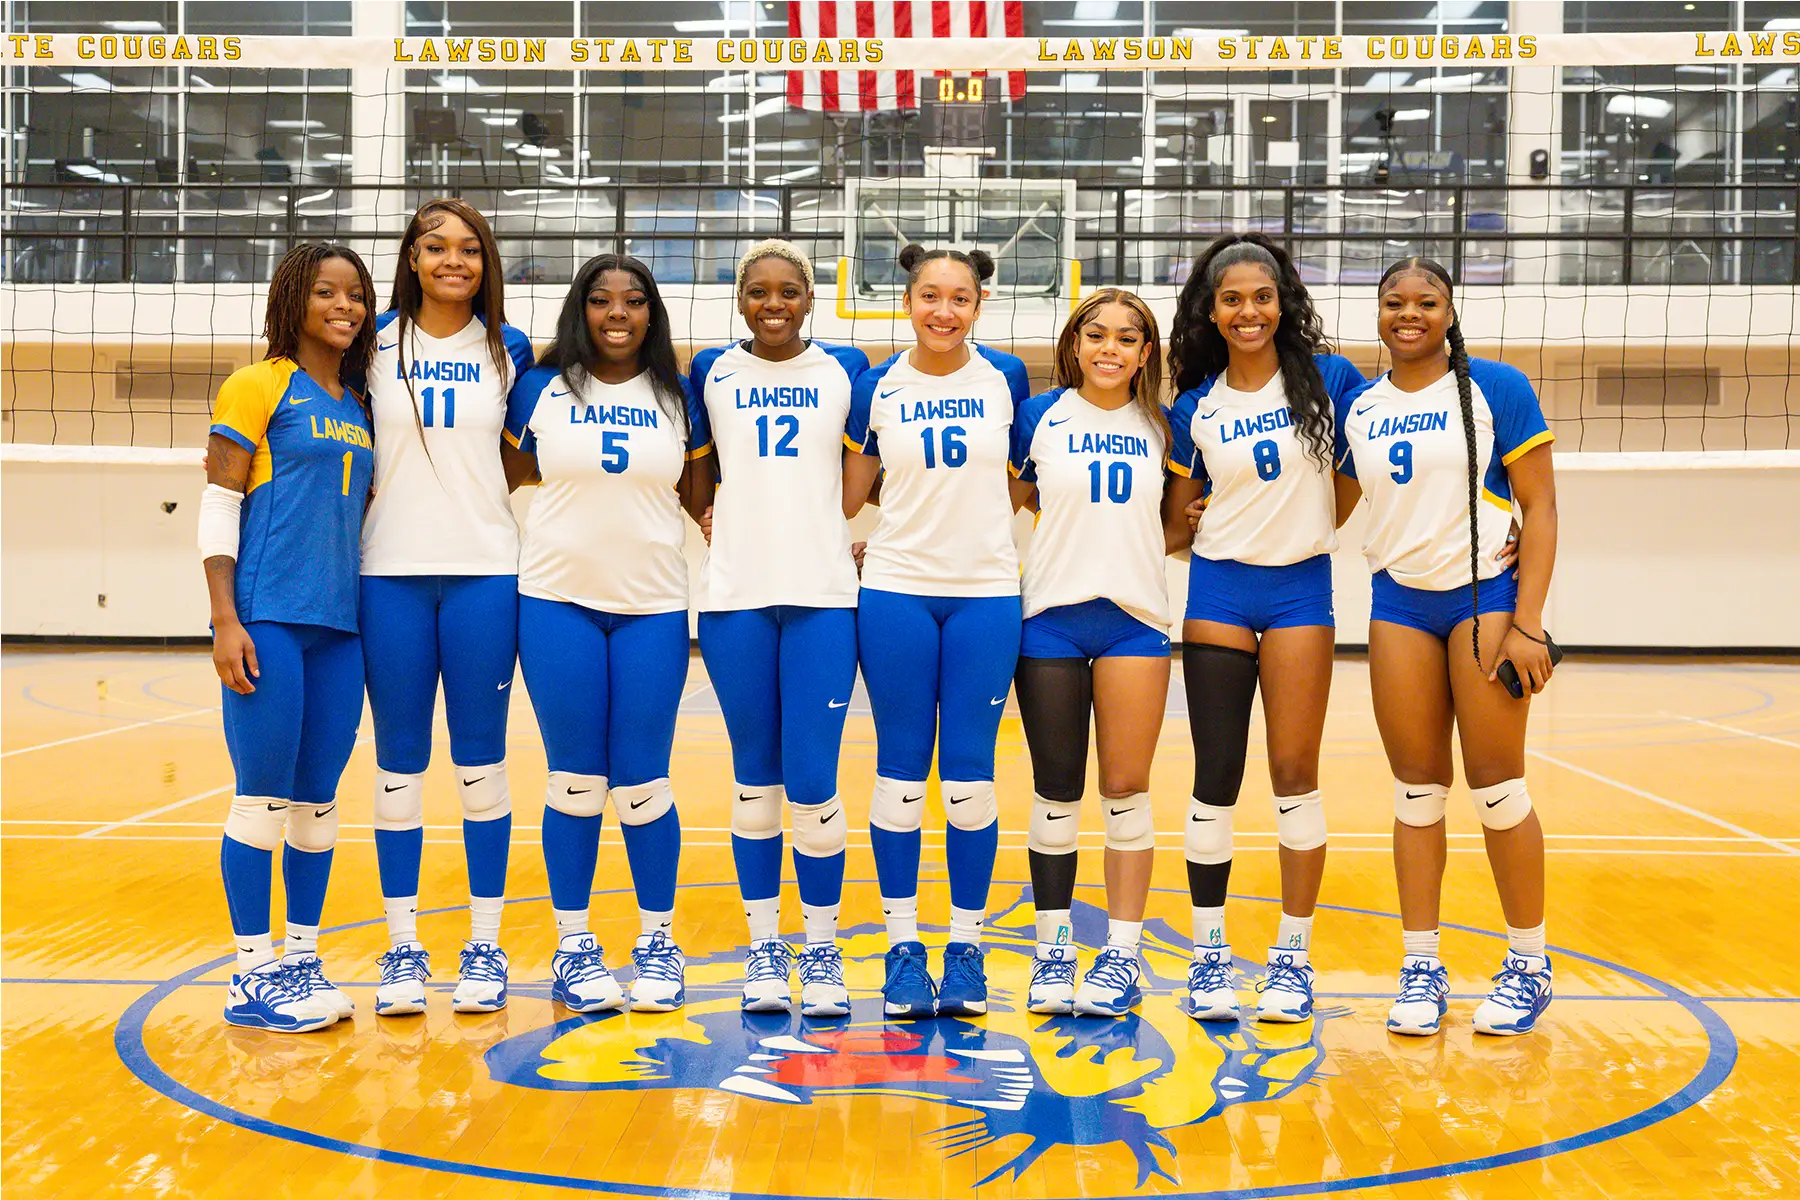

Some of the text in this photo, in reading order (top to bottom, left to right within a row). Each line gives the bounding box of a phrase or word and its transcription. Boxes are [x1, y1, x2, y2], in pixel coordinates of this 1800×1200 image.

[1, 35, 242, 60] TE COUGARS
[394, 38, 885, 63] LAWSON STATE COUGARS
[1038, 35, 1538, 61] LAWSON STATE COUGARS
[1695, 32, 1800, 56] LAWS
[939, 78, 983, 102] 0.0
[397, 360, 481, 383] LAWSON
[421, 386, 455, 428] 11
[736, 387, 819, 409] LAWSON
[900, 398, 984, 423] LAWSON
[570, 405, 658, 429] LAWSON
[1368, 411, 1448, 440] LAWSON
[755, 415, 799, 457] 12
[920, 425, 968, 469] 16
[1068, 433, 1149, 458] LAWSON
[601, 431, 630, 474] 5
[1253, 439, 1281, 482] 8
[1389, 440, 1413, 484] 9
[341, 451, 353, 496] 1
[1088, 460, 1133, 504] 10
